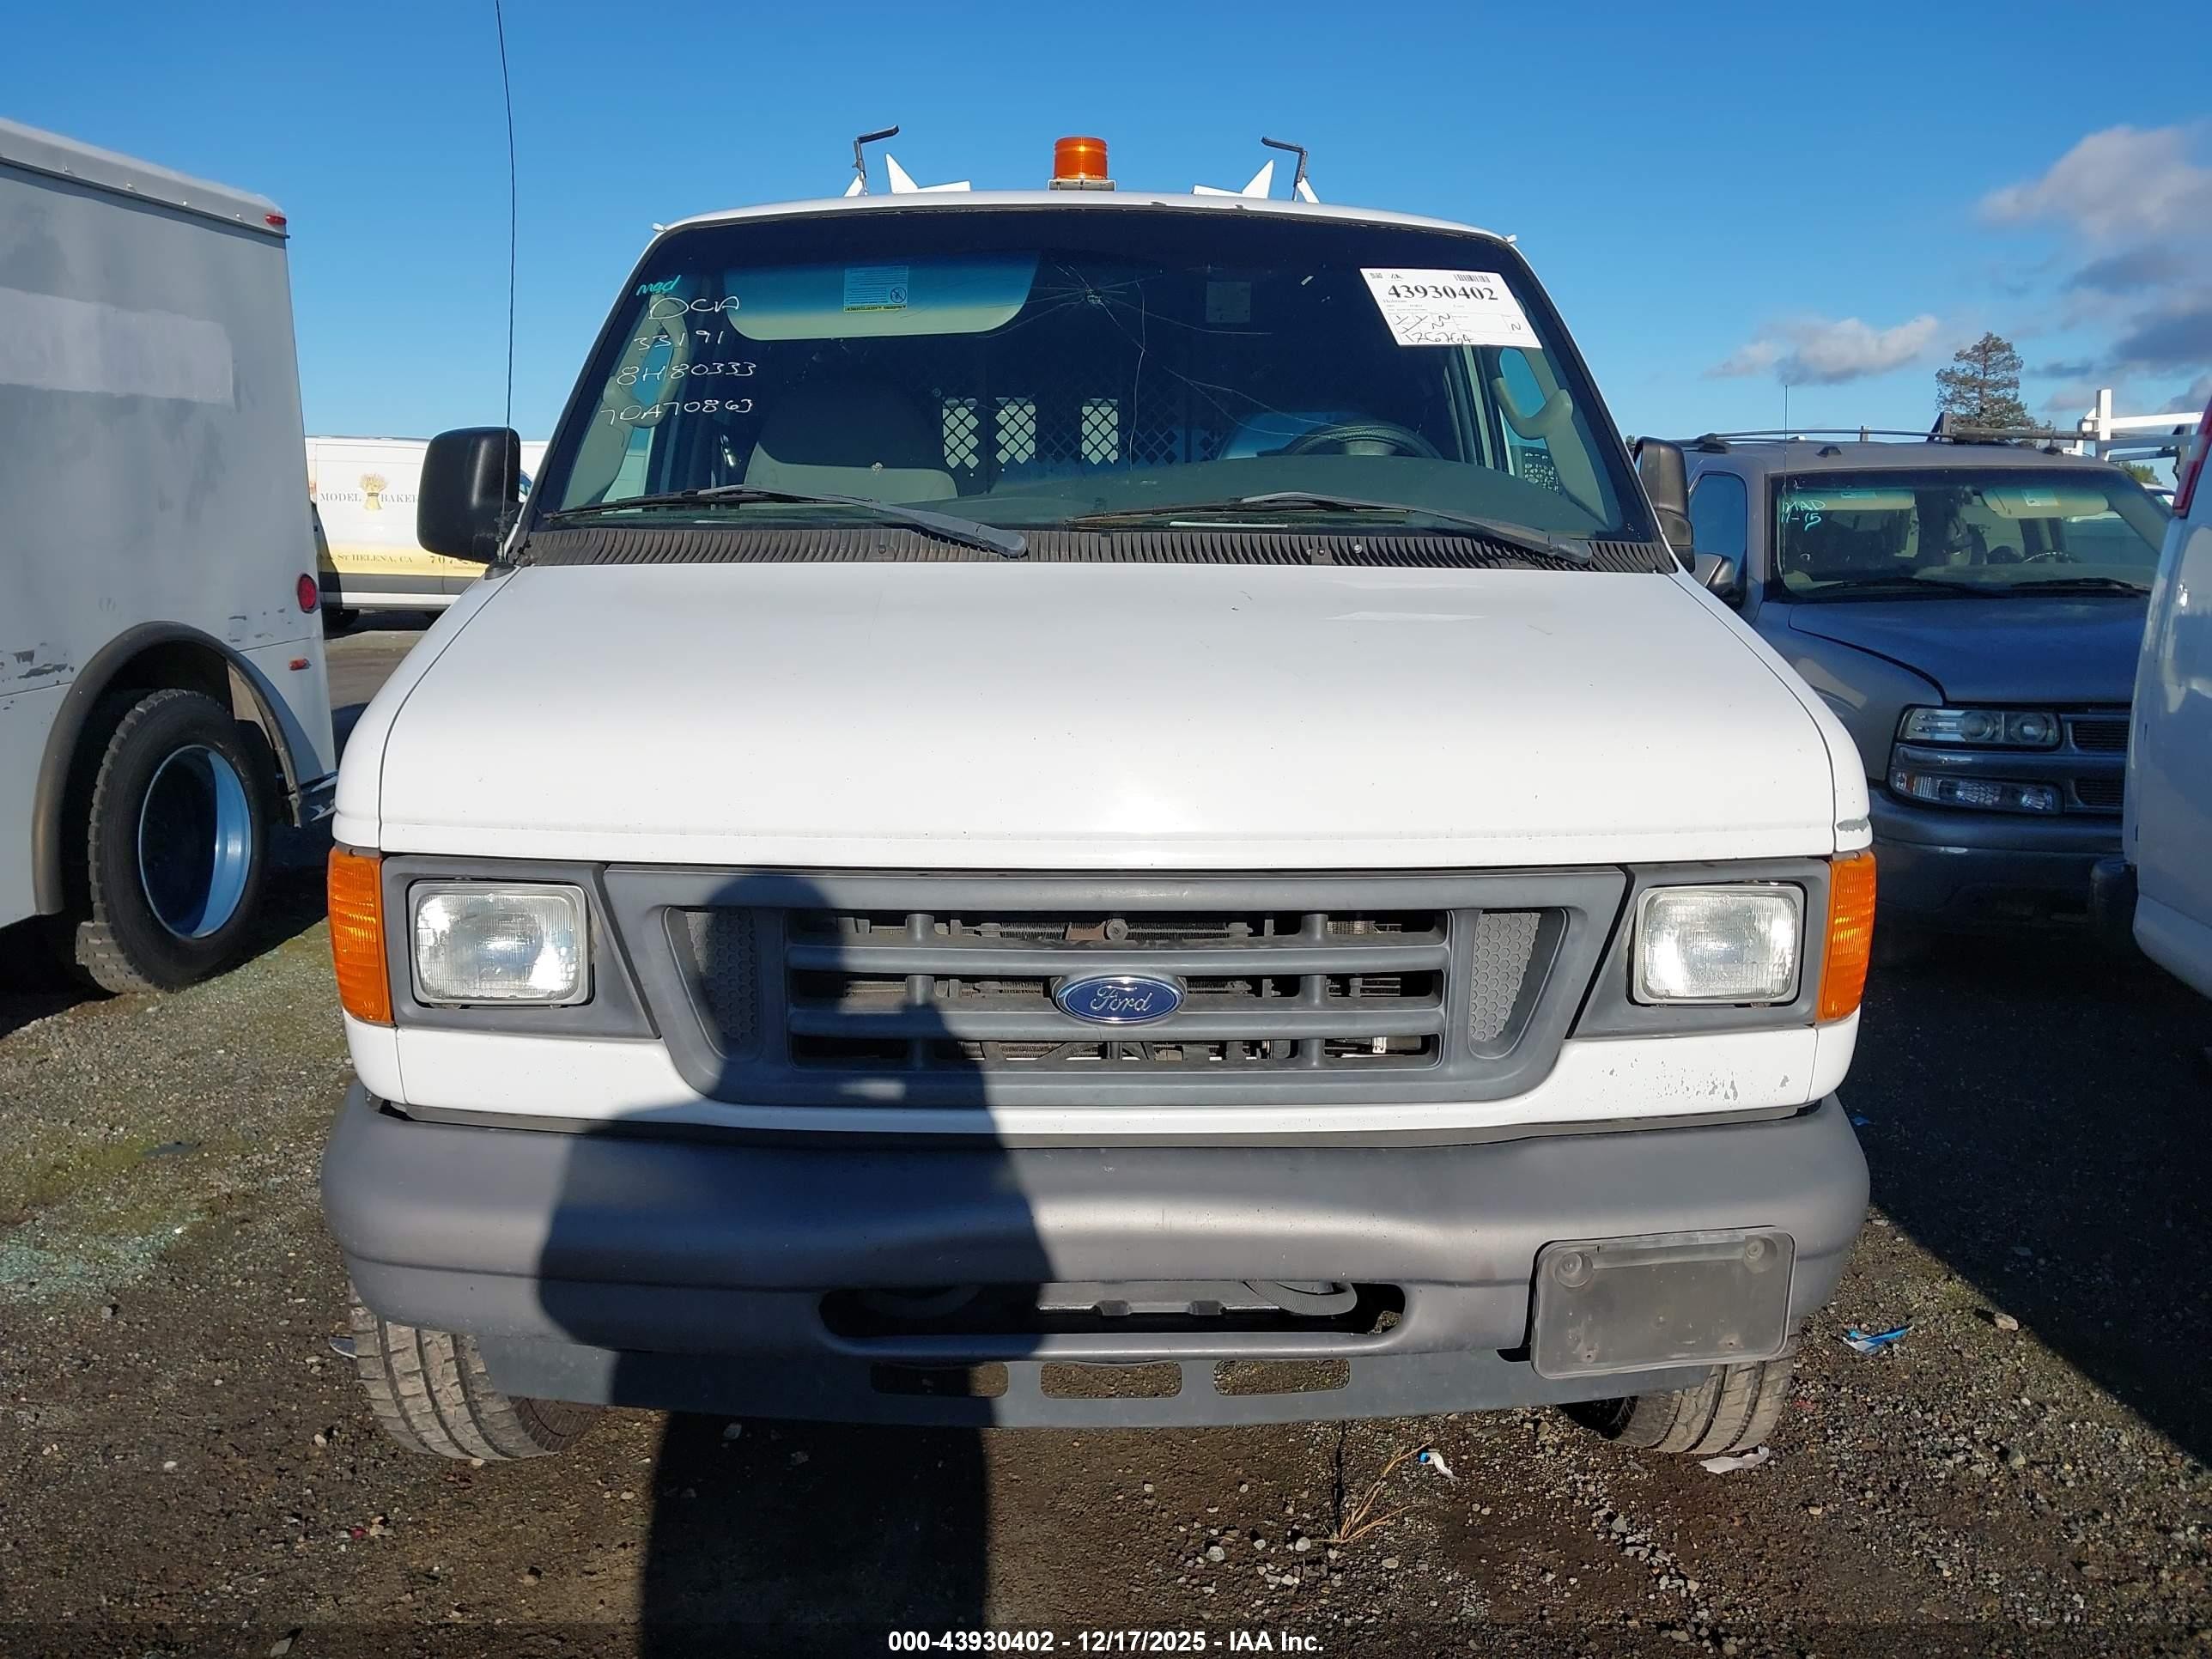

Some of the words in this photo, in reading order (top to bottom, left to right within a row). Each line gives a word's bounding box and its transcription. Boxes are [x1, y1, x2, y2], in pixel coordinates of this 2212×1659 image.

[1388, 284, 1499, 301] 43930402
[617, 362, 757, 386] 8H80333
[320, 493, 362, 502] MODEL
[1089, 984, 1153, 1012] Ford
